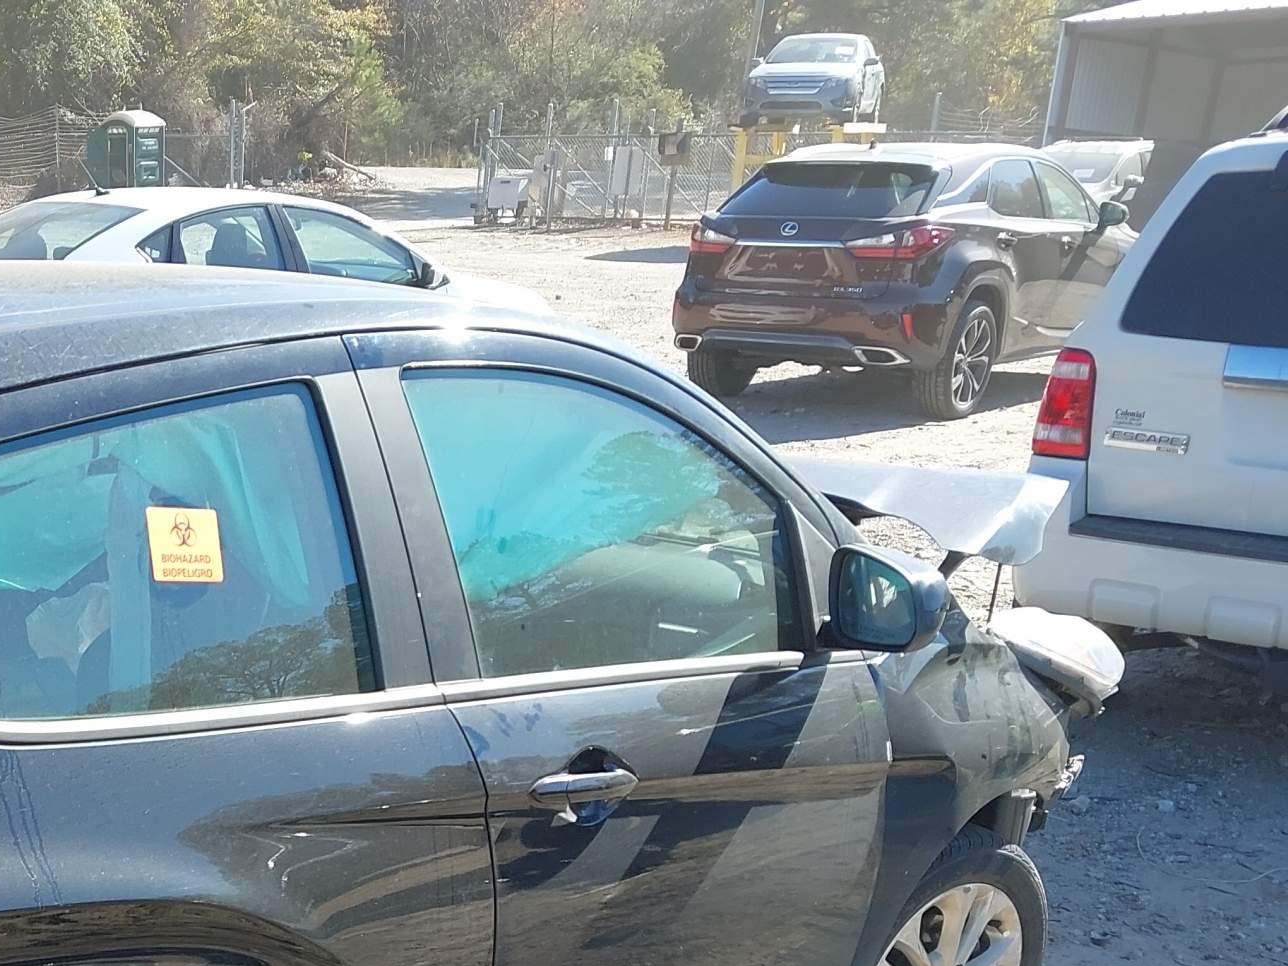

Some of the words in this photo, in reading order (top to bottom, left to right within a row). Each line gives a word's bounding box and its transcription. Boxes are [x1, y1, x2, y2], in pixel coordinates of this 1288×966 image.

[1112, 431, 1182, 446] ESCAPE
[161, 553, 211, 564] BIOHAZARD
[162, 567, 213, 578] BIOPELIGRO
